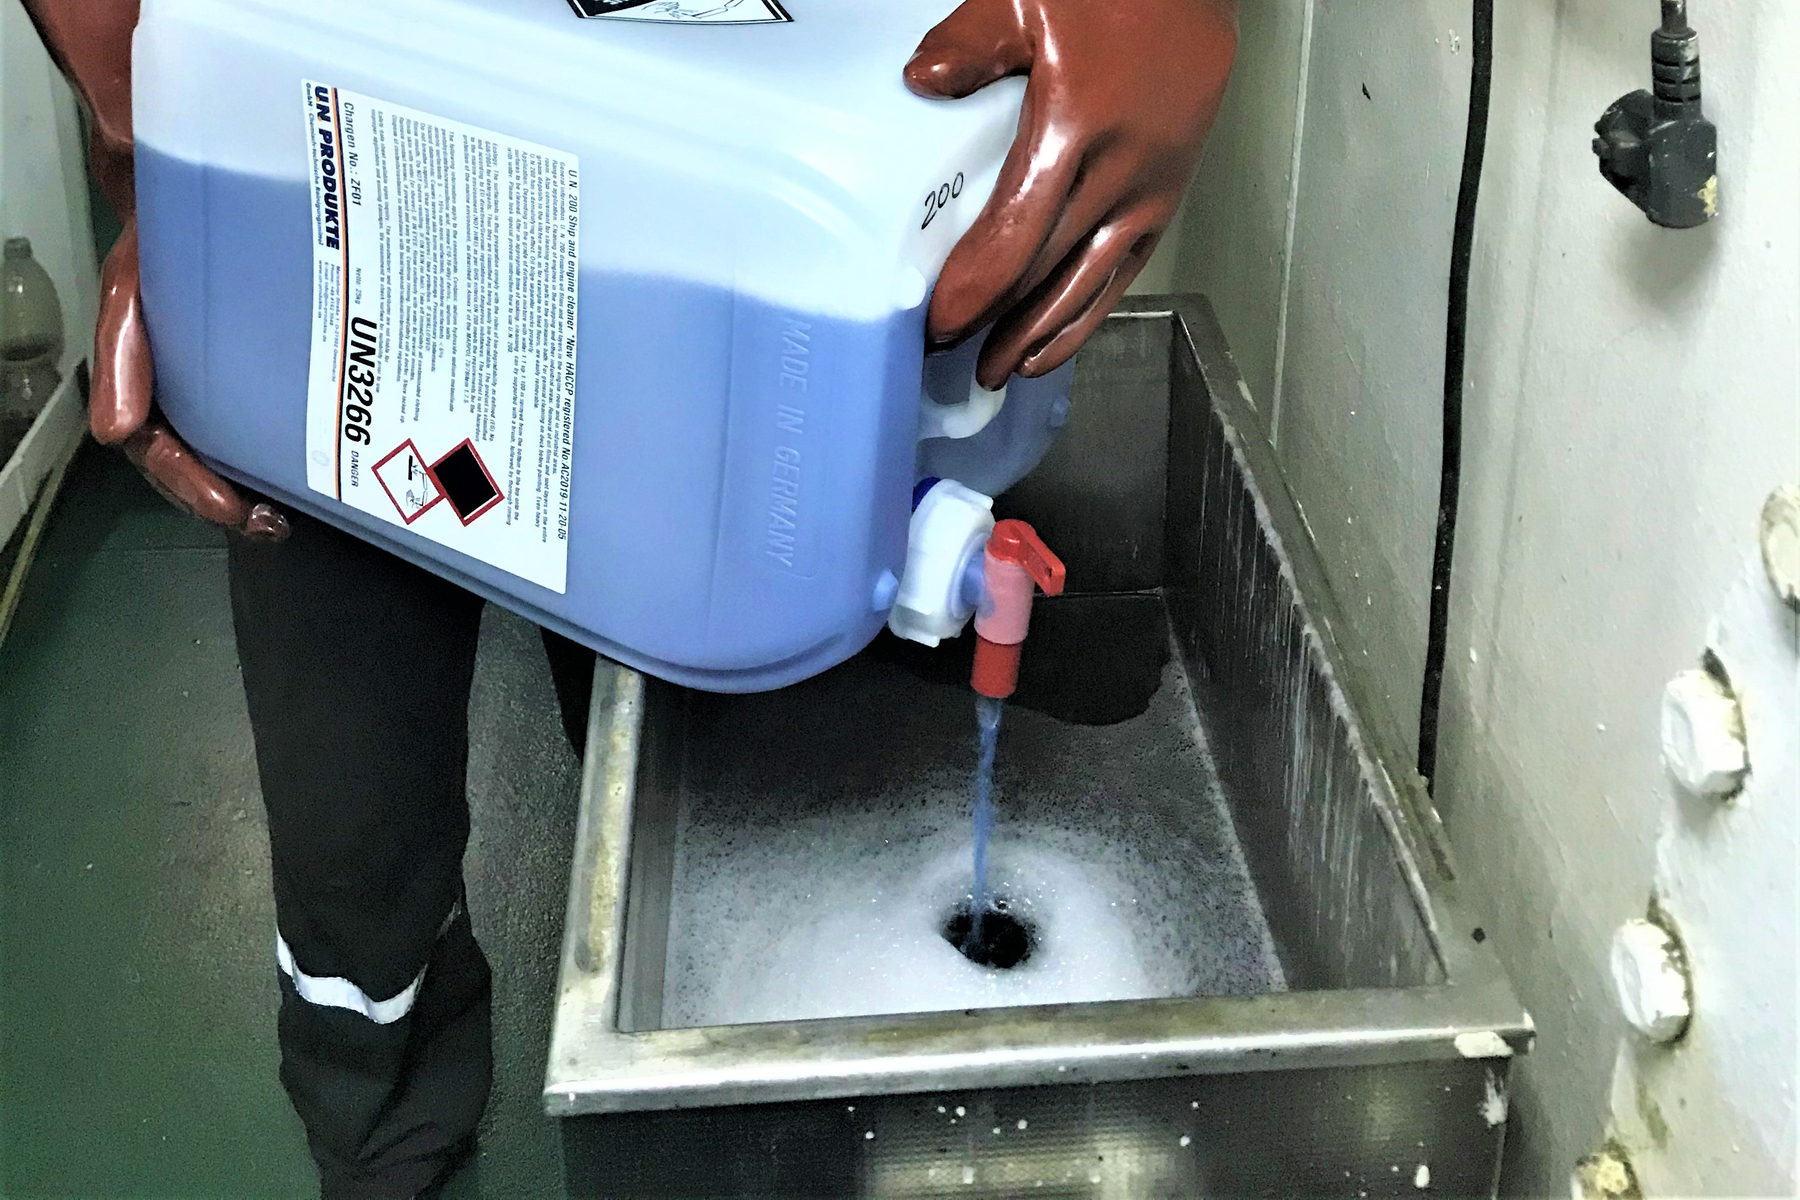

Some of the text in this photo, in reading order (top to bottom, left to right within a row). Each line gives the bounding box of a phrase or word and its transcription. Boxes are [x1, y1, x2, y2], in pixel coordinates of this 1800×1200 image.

[344, 102, 357, 148] Chargen
[351, 178, 361, 206] ZF01
[319, 128, 340, 250] PRODUKTE
[568, 194, 577, 212] 200
[921, 172, 964, 230] 200
[567, 216, 577, 236] Ship
[568, 240, 576, 257] and
[566, 261, 576, 292] engine
[566, 296, 575, 330] cleaner
[345, 317, 378, 446] UN3266
[564, 362, 573, 395] HACCP
[561, 398, 572, 444] registered
[766, 316, 812, 568] MADE IN GERMANY
[350, 450, 359, 488] DANGER
